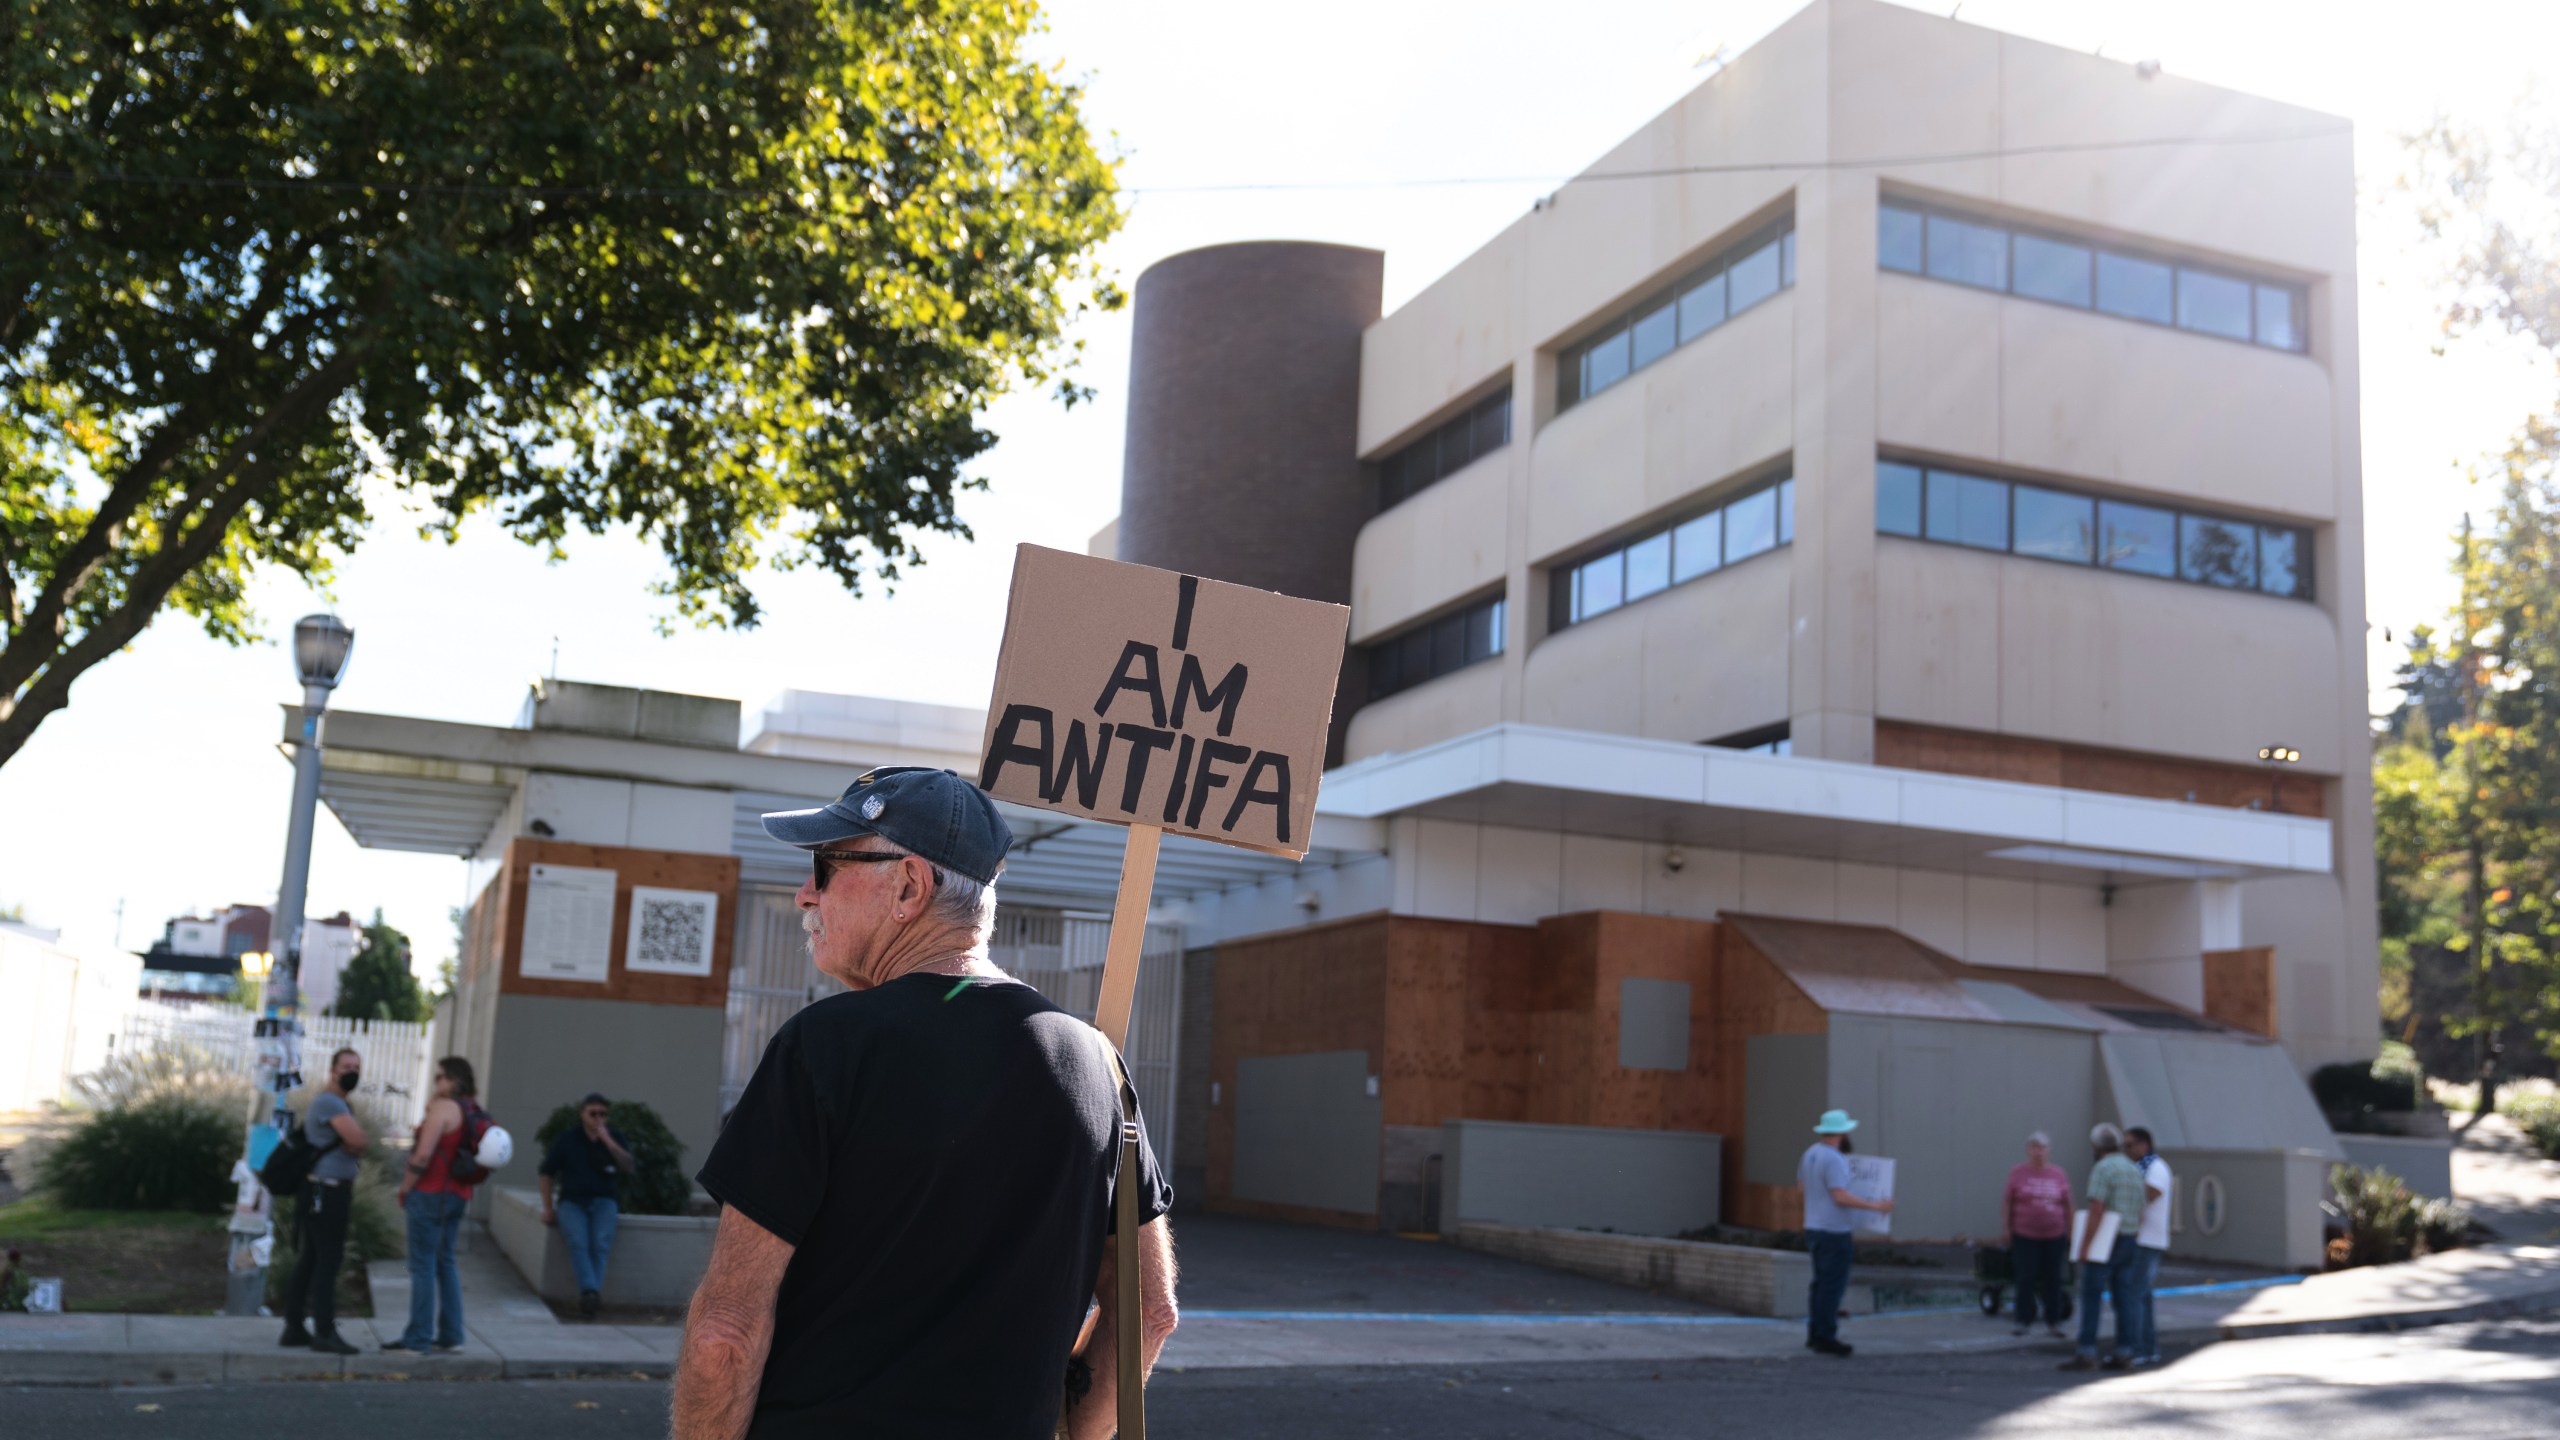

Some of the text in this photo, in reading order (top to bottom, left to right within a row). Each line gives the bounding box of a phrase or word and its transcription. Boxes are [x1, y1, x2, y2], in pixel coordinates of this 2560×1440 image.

[1172, 574, 1198, 651] I
[1093, 640, 1249, 737] AM
[979, 703, 1291, 843] ANTIFA
